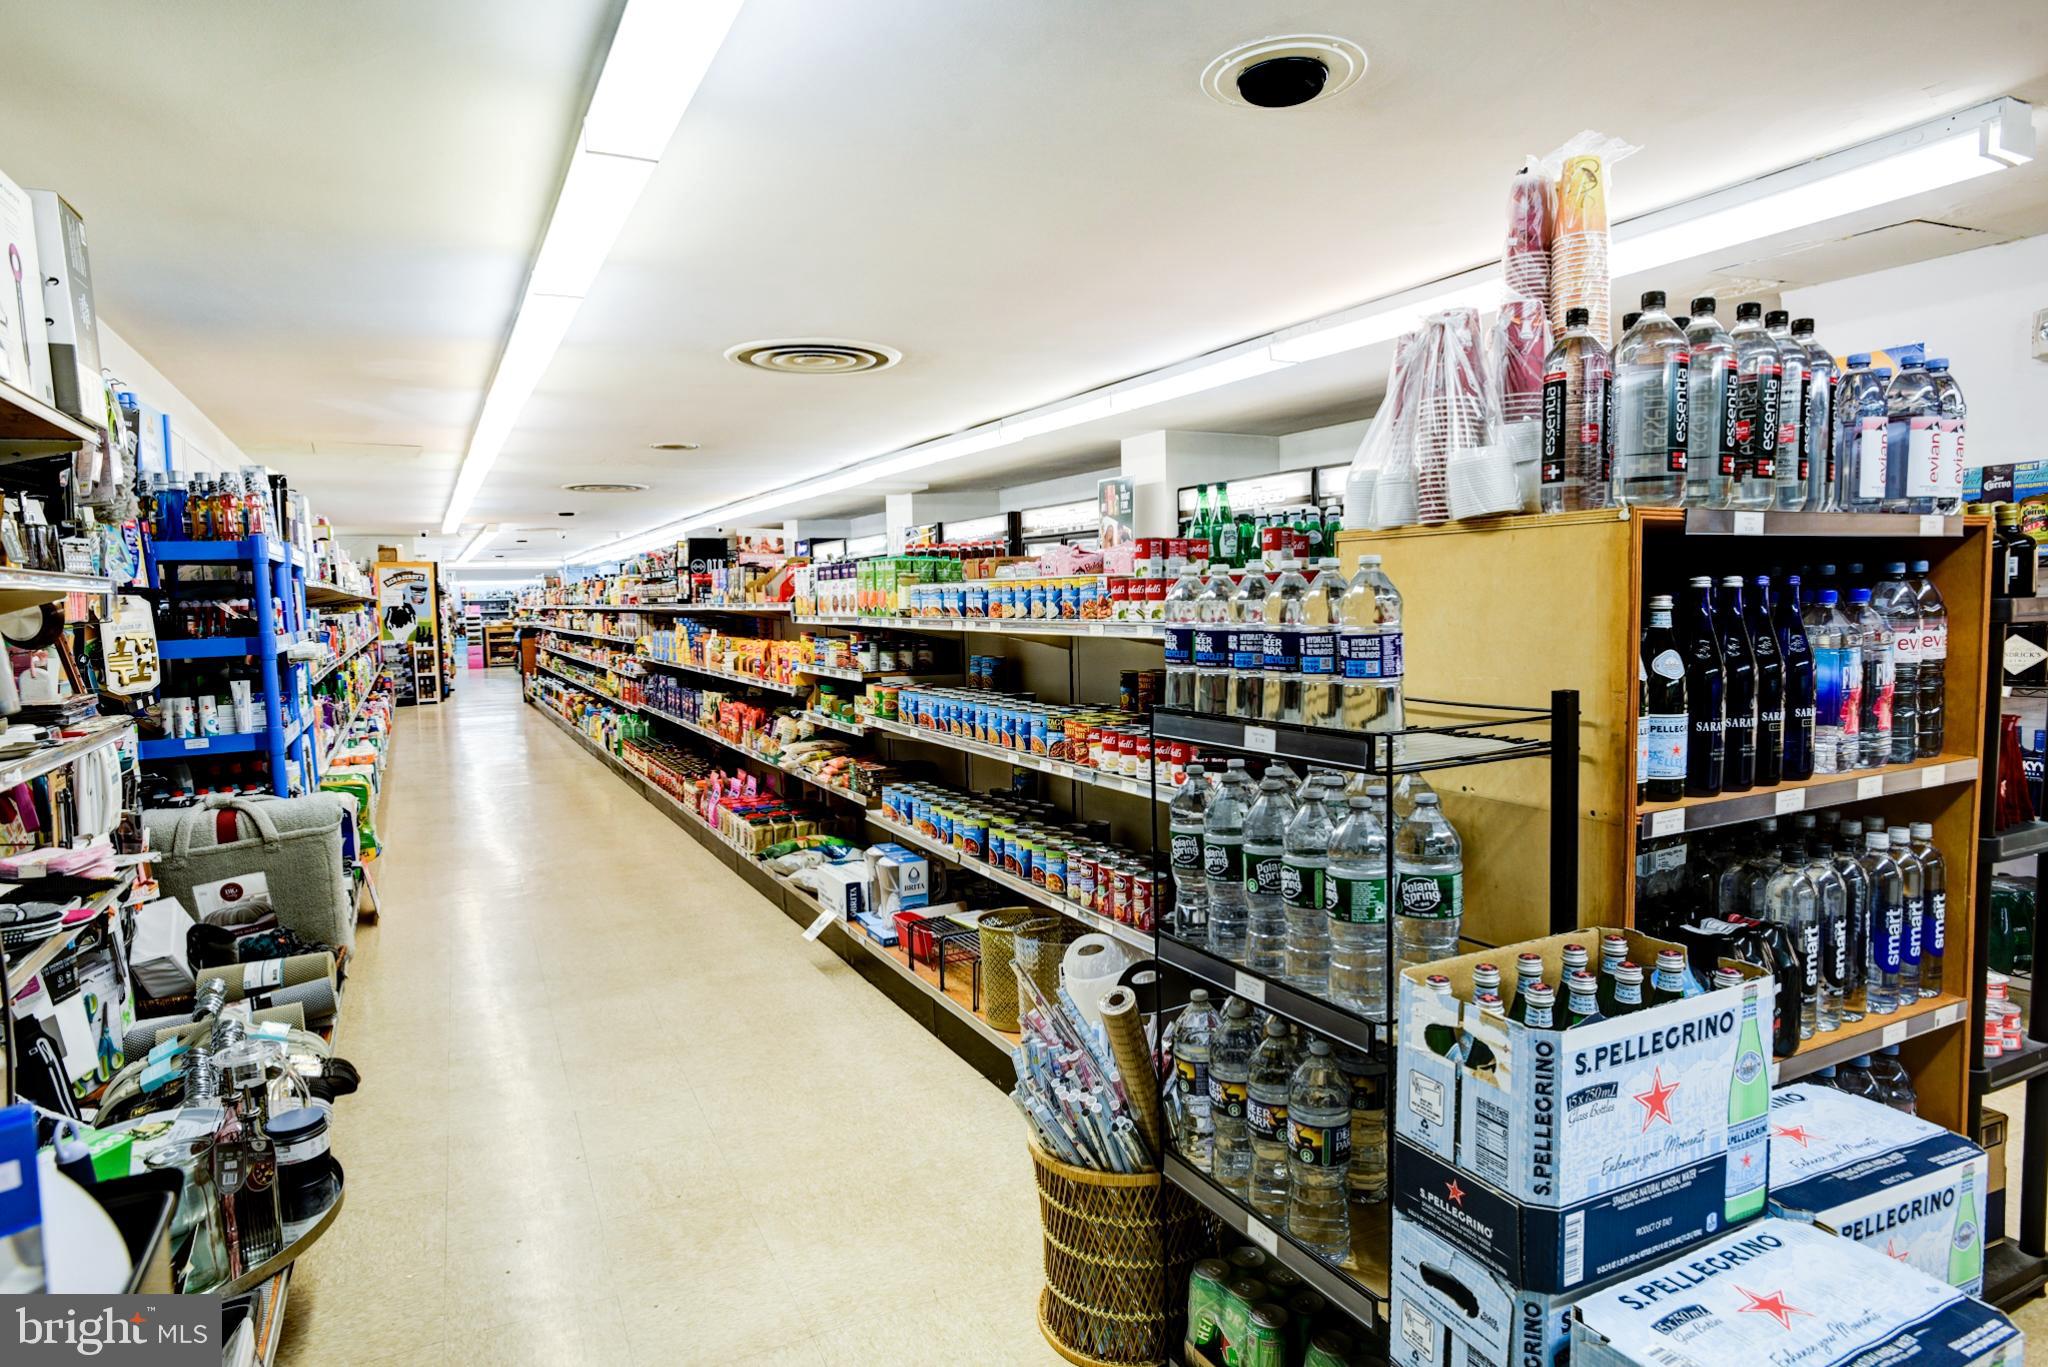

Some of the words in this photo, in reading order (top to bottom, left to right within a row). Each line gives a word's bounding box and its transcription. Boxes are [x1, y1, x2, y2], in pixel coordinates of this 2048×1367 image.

[1545, 386, 1557, 456] essentia
[1675, 367, 1689, 443] essentia
[1726, 374, 1738, 447] essentia
[1763, 379, 1778, 451] essentia
[1927, 432, 1941, 483] evian
[1953, 435, 1965, 485] evian
[904, 883, 925, 892] BRITA
[1401, 878, 1439, 893] Poland
[1402, 889, 1442, 907] Spring
[1834, 918, 1847, 980] smart
[1886, 908, 1901, 967] smart
[1909, 900, 1923, 957] smart
[1933, 893, 1946, 950] smart
[1804, 925, 1819, 987] smart
[1575, 1010, 1735, 1076] S.PELLEGRINO
[1533, 1040, 1555, 1197] S.PELLEGRINO
[1601, 1151, 1641, 1177] Enhance
[1419, 1187, 1494, 1240] S.PELLEGRINO
[1841, 1187, 1956, 1242] PELLEGRINO
[1617, 1232, 1783, 1311] S.PELLEGRINO
